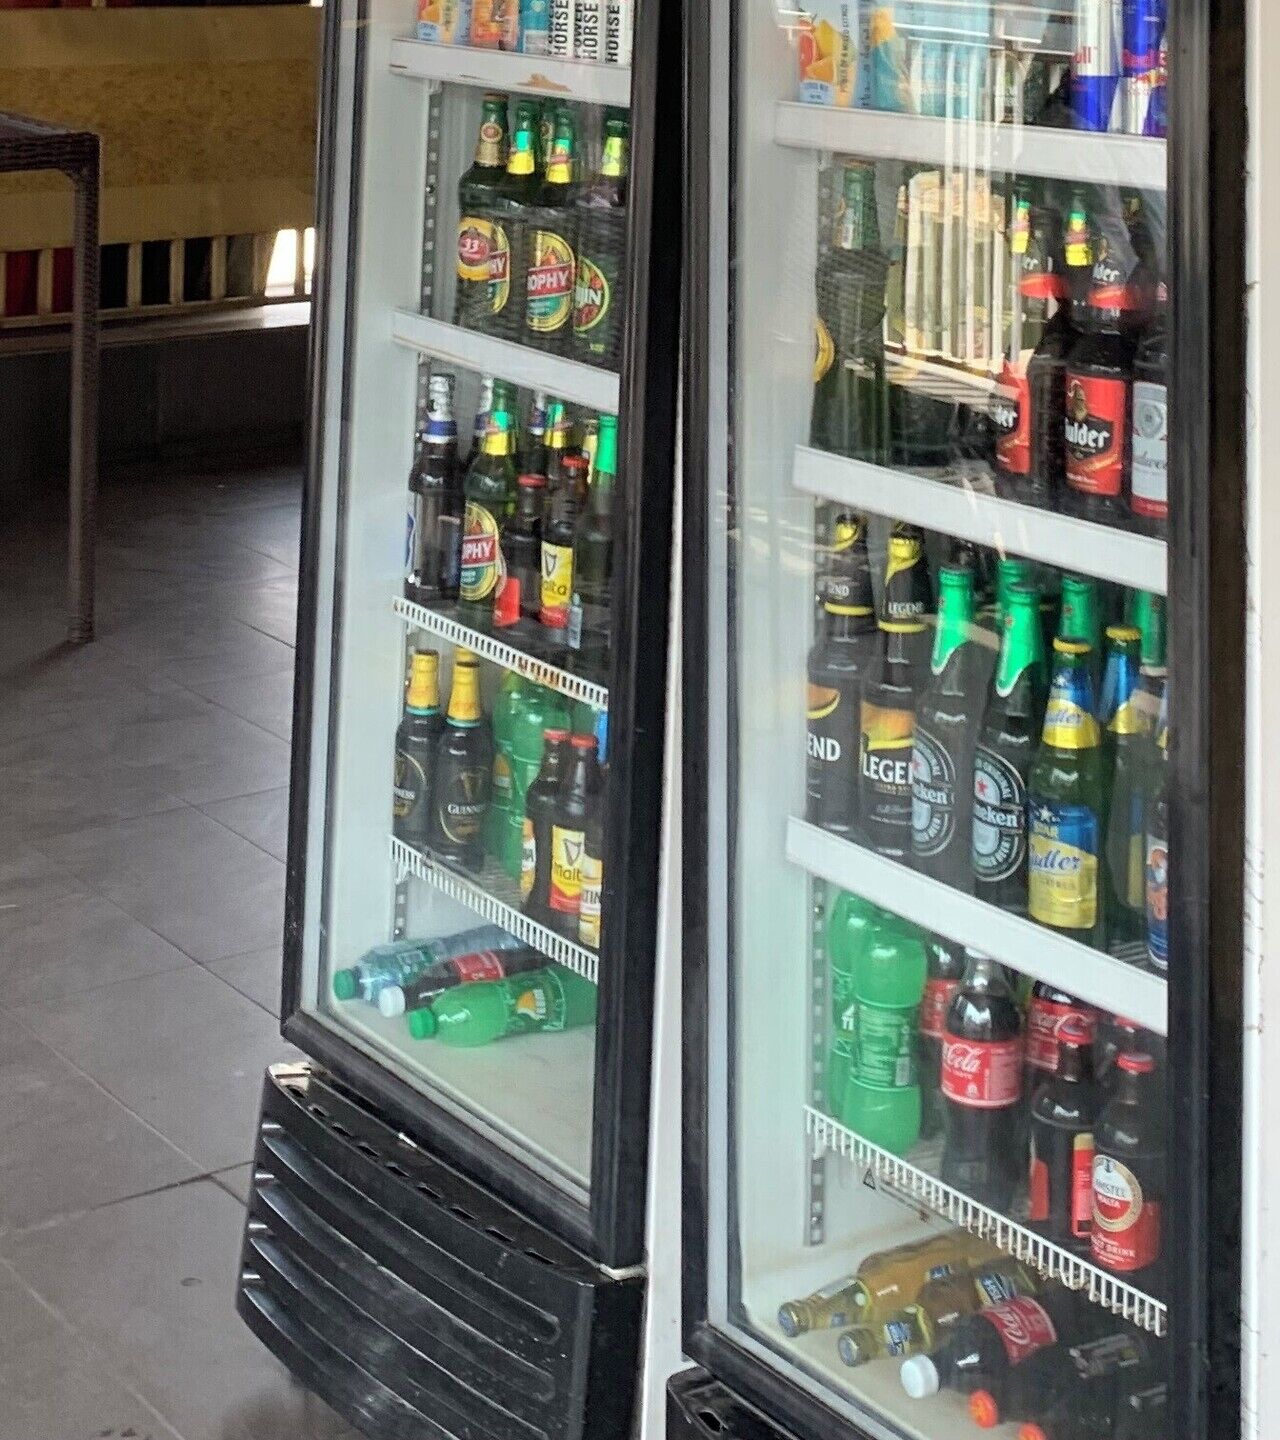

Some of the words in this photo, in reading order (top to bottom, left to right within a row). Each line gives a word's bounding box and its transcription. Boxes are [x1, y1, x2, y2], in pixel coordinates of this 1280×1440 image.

[553, 0, 568, 56] HORSE
[582, 3, 599, 60] HORSE
[605, 5, 620, 63] HORSE
